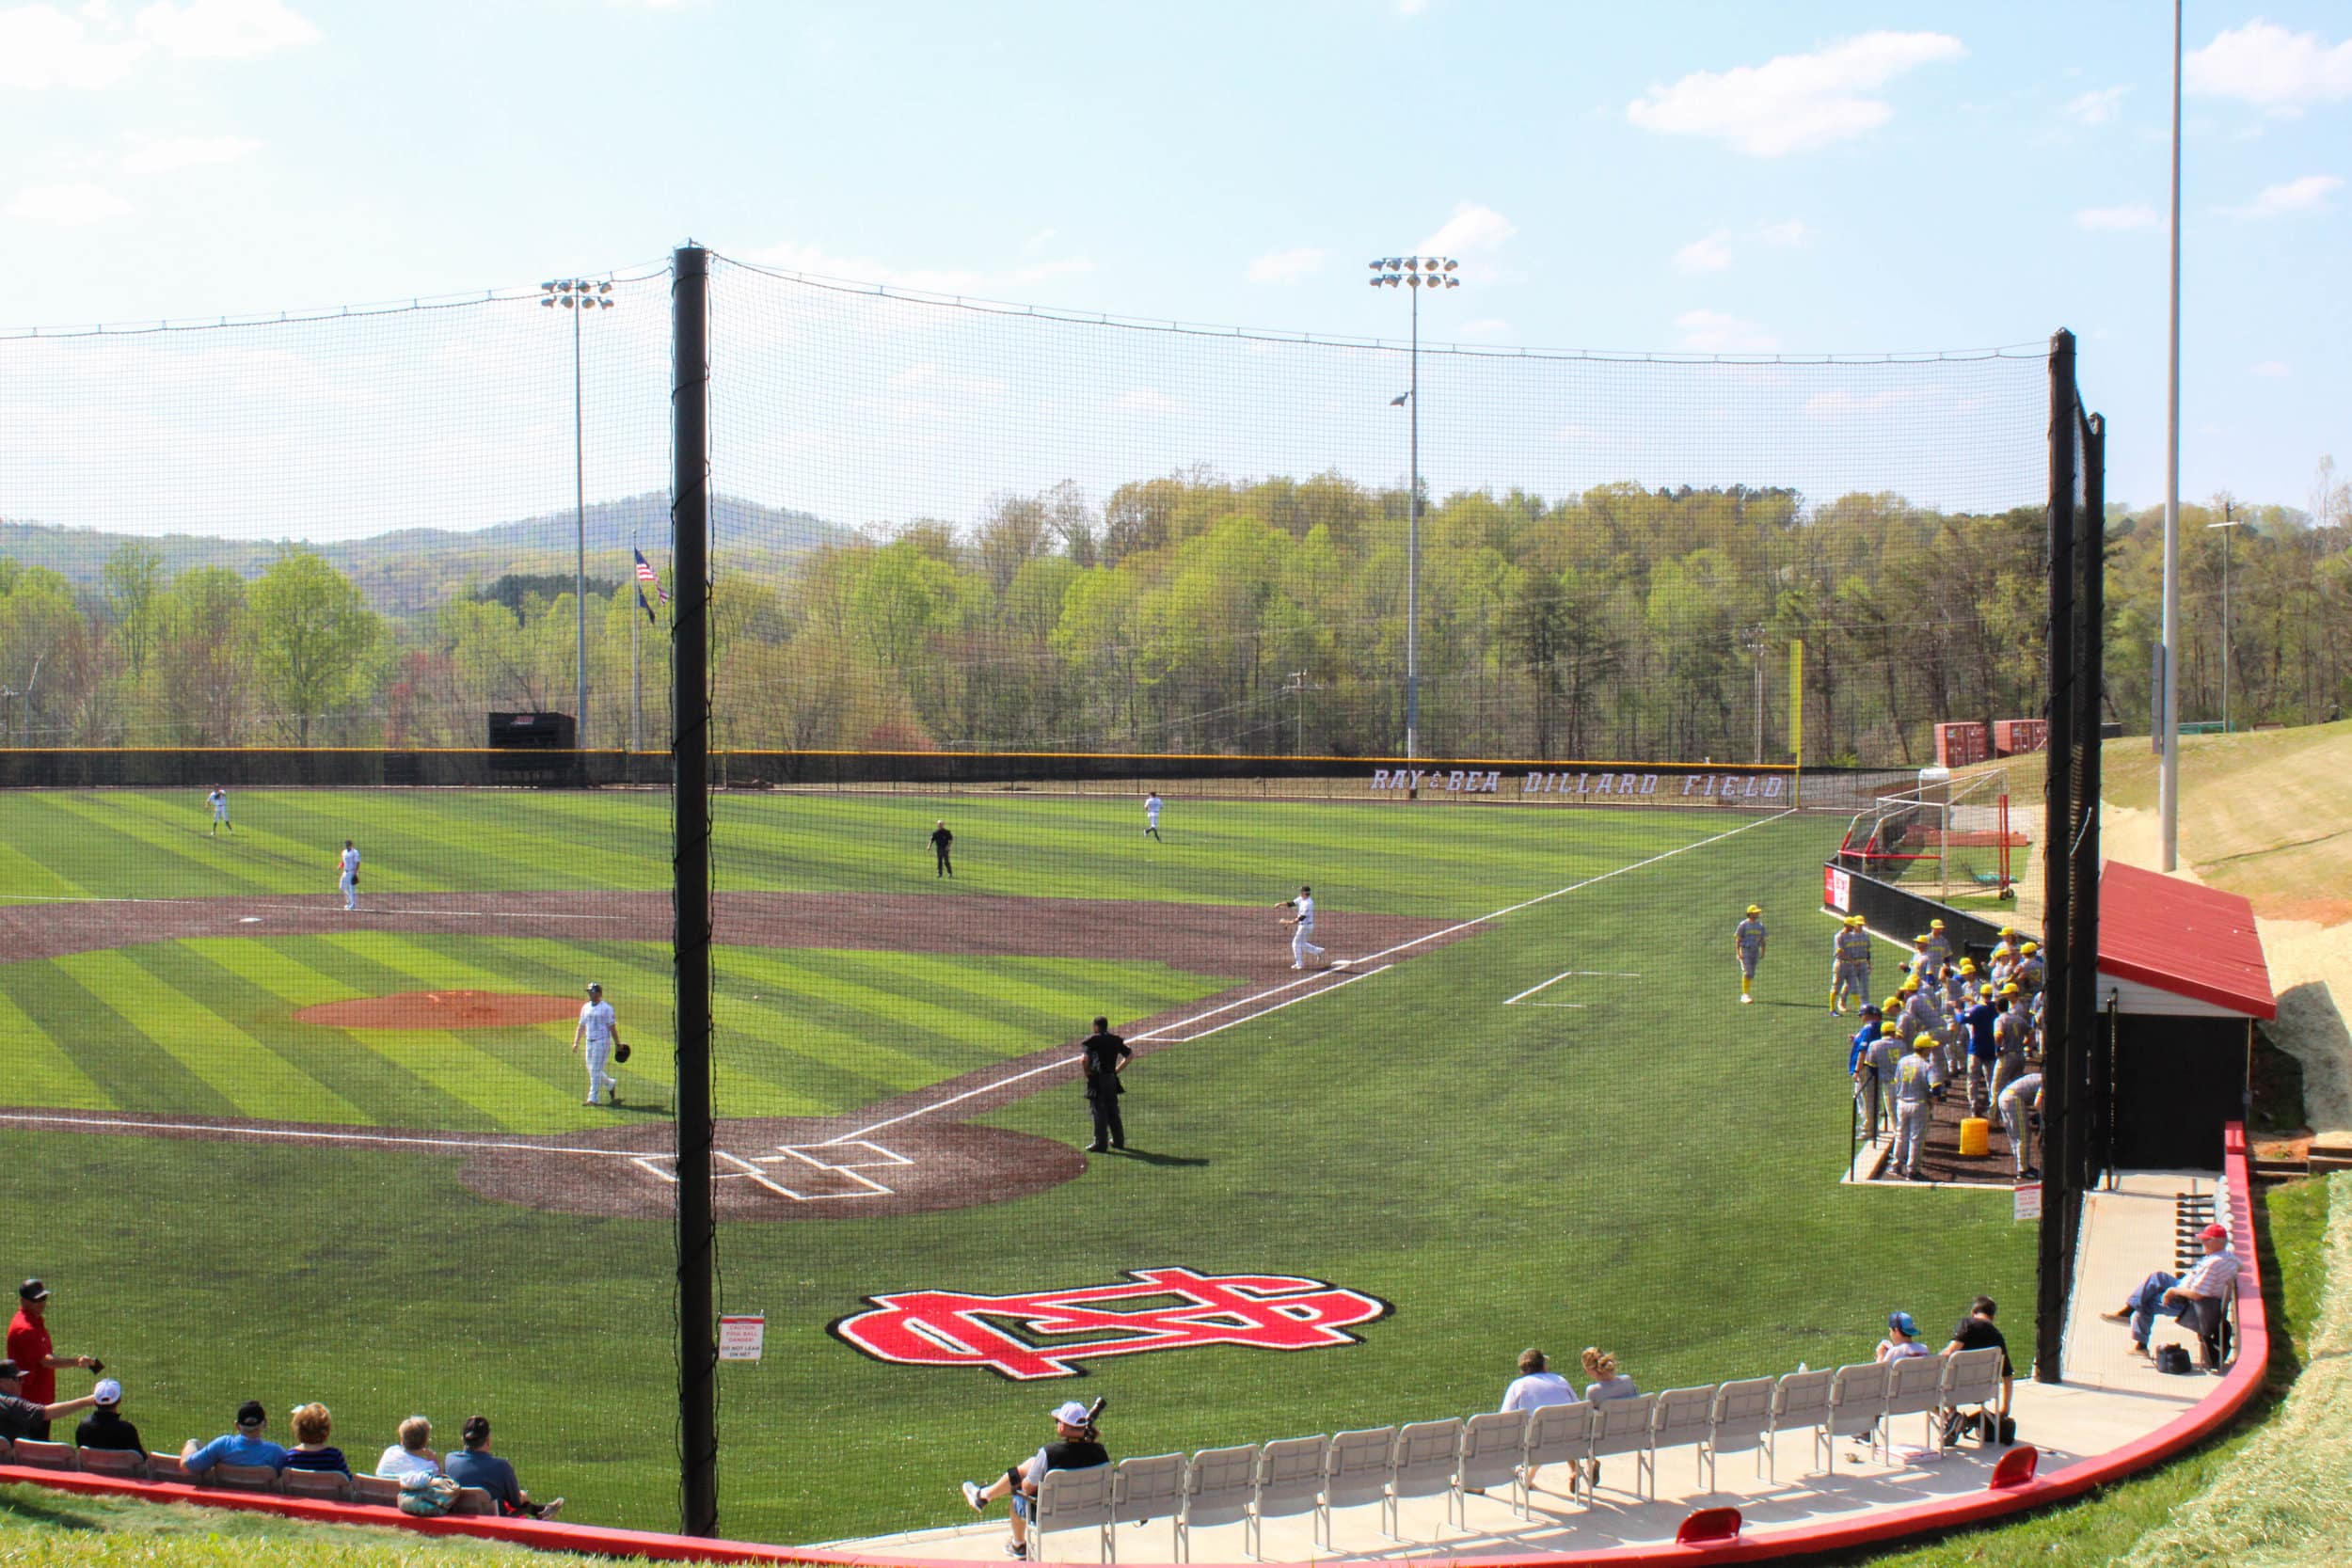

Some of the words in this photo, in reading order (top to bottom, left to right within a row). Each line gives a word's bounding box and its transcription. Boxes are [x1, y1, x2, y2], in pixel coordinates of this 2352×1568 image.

[1371, 769, 1422, 790] RAY
[1429, 771, 1442, 789] &
[1446, 770, 1501, 792] BEA
[1523, 772, 1659, 795] DILLARD
[1682, 774, 1784, 798] FIELD
